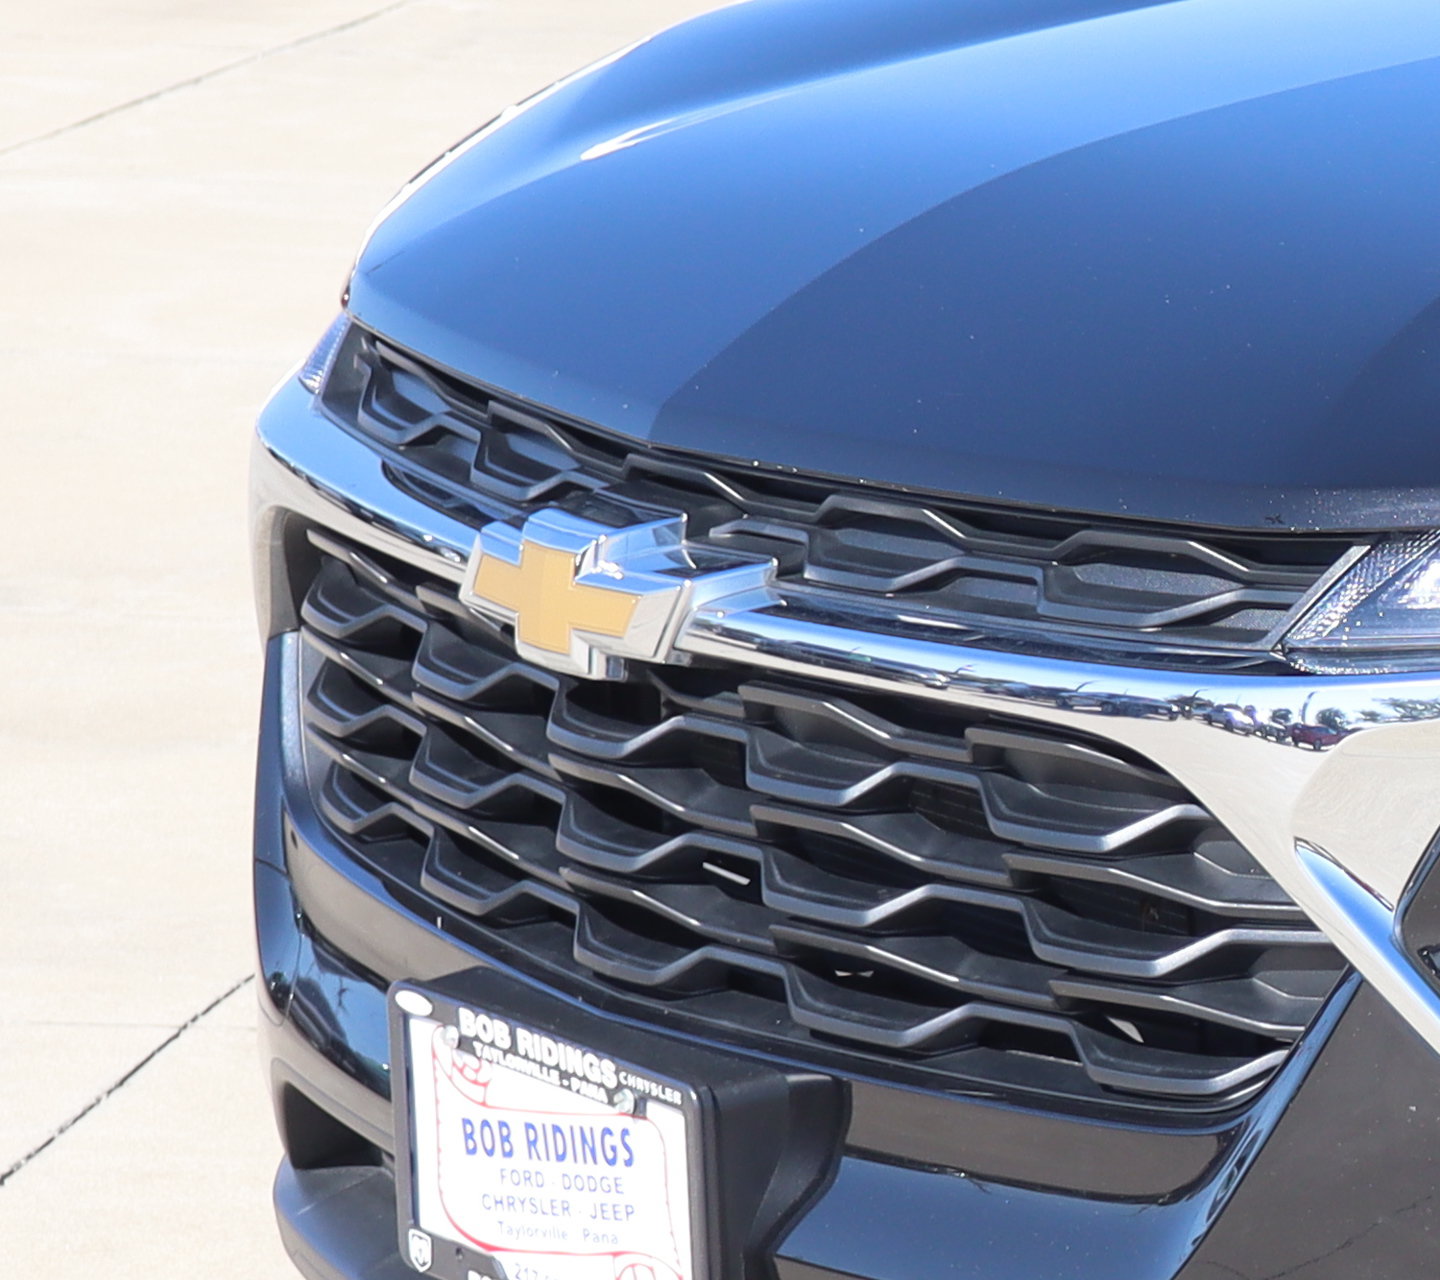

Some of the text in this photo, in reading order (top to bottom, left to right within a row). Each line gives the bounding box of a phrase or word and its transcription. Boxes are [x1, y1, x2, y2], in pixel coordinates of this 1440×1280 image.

[458, 1007, 618, 1090] BOB RIDINGS
[570, 1077, 609, 1105] PANA
[618, 1071, 683, 1105] CHRYSLER
[461, 1117, 635, 1168] BOB RIDINGS
[499, 1168, 625, 1195] FORD DODGE
[482, 1193, 636, 1222] CHRYSLER JEEP
[497, 1220, 620, 1246] Taylorville Pana
